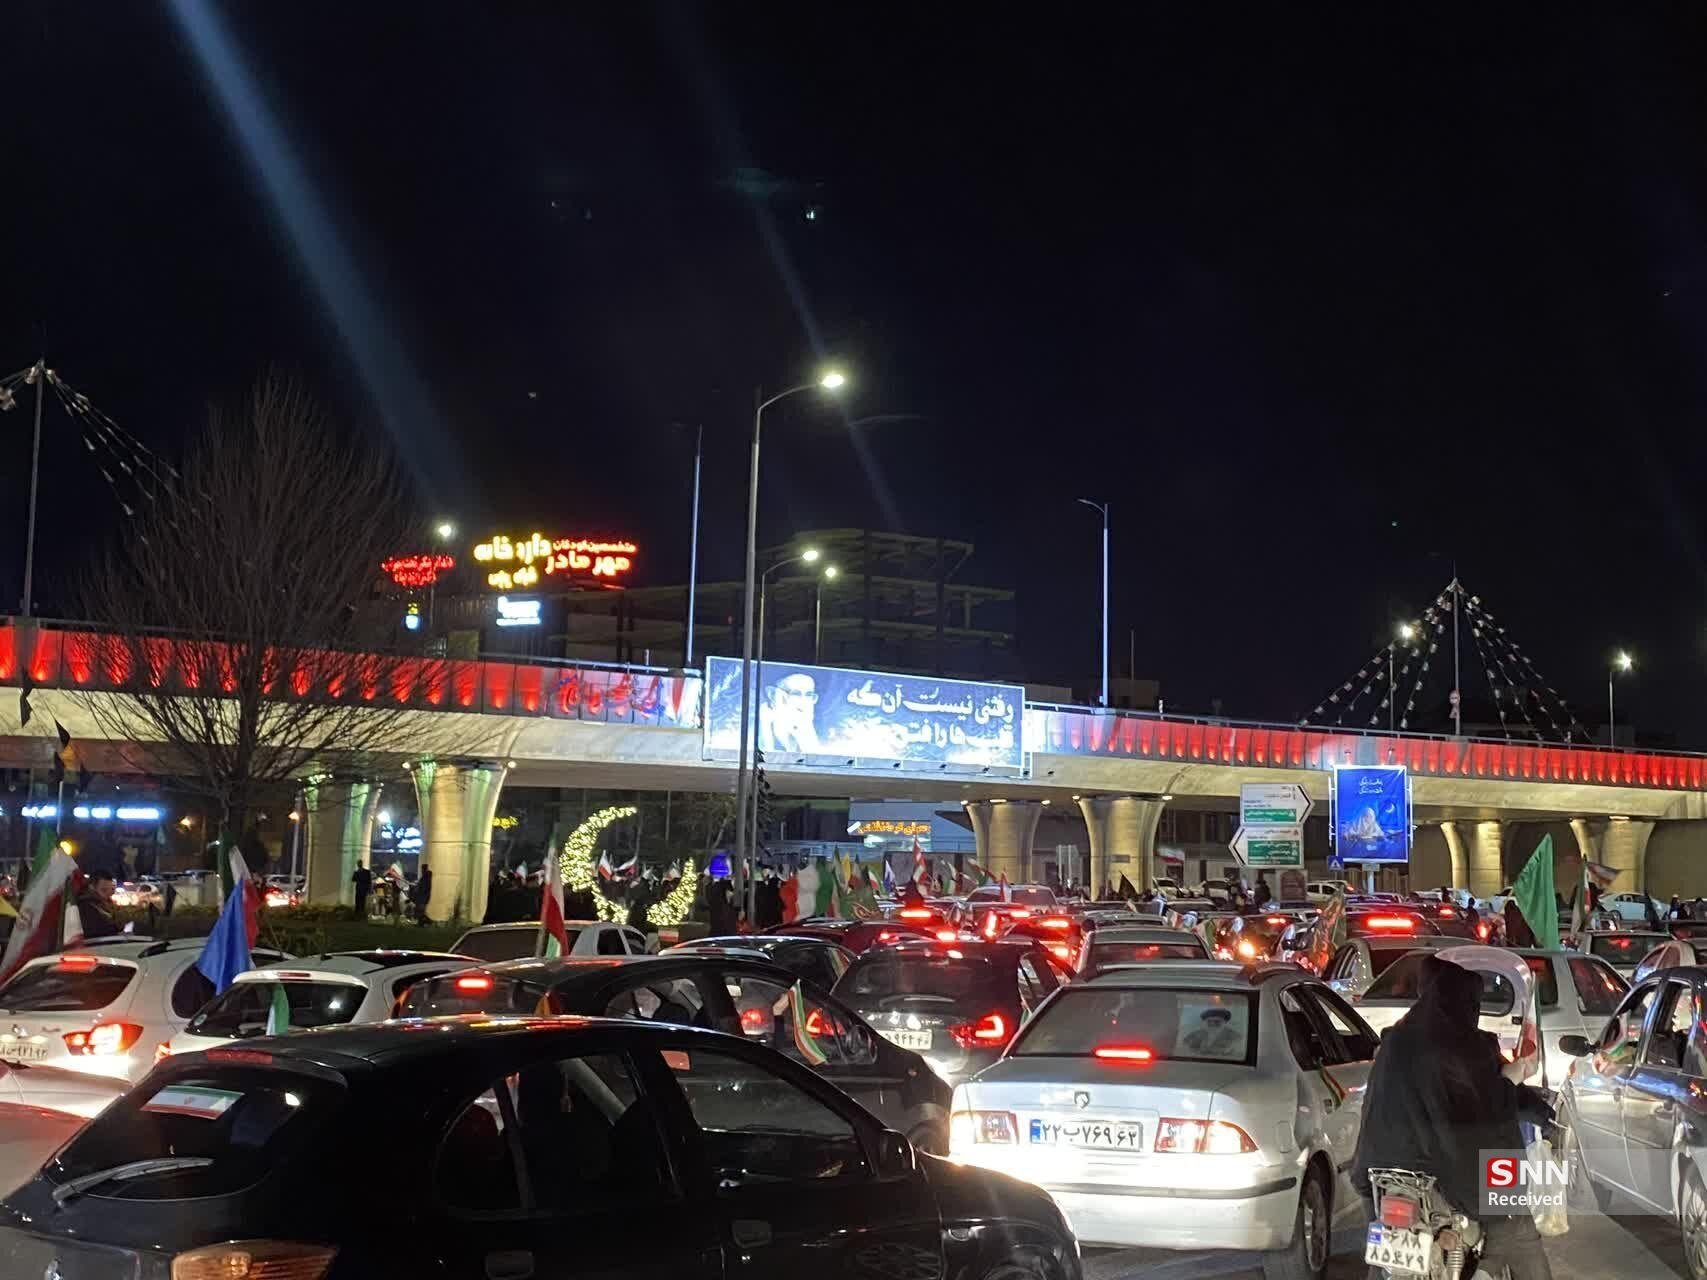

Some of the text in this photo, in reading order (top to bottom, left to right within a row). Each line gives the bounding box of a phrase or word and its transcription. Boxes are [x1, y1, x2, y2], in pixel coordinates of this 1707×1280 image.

[545, 550, 630, 576] مهر مادر
[903, 686, 974, 721] نیست
